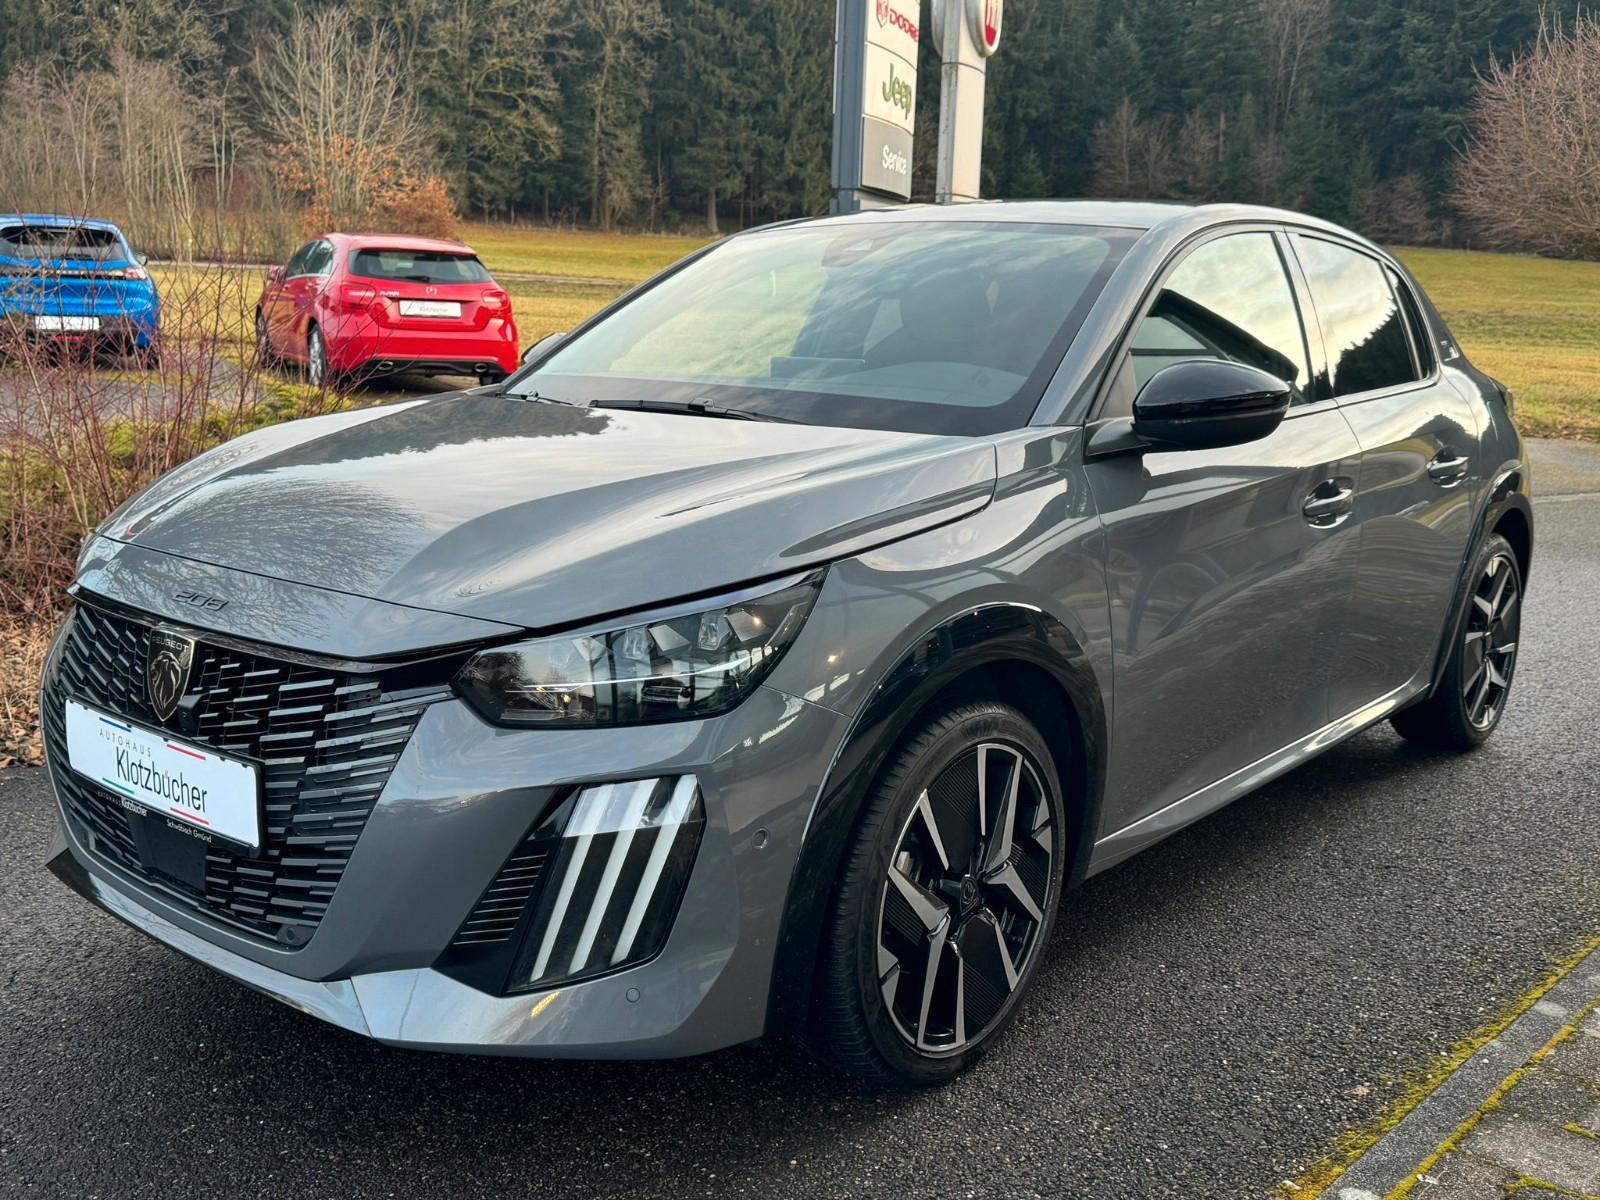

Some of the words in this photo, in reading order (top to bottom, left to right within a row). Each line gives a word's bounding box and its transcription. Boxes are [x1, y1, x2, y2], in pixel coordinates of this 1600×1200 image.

[882, 63, 912, 120] Jeep
[881, 144, 907, 175] Service
[172, 590, 229, 612] 208
[151, 635, 189, 652] PEUGEOT
[99, 728, 151, 758] AUTOHAUS
[116, 746, 208, 813] Klotzbücher
